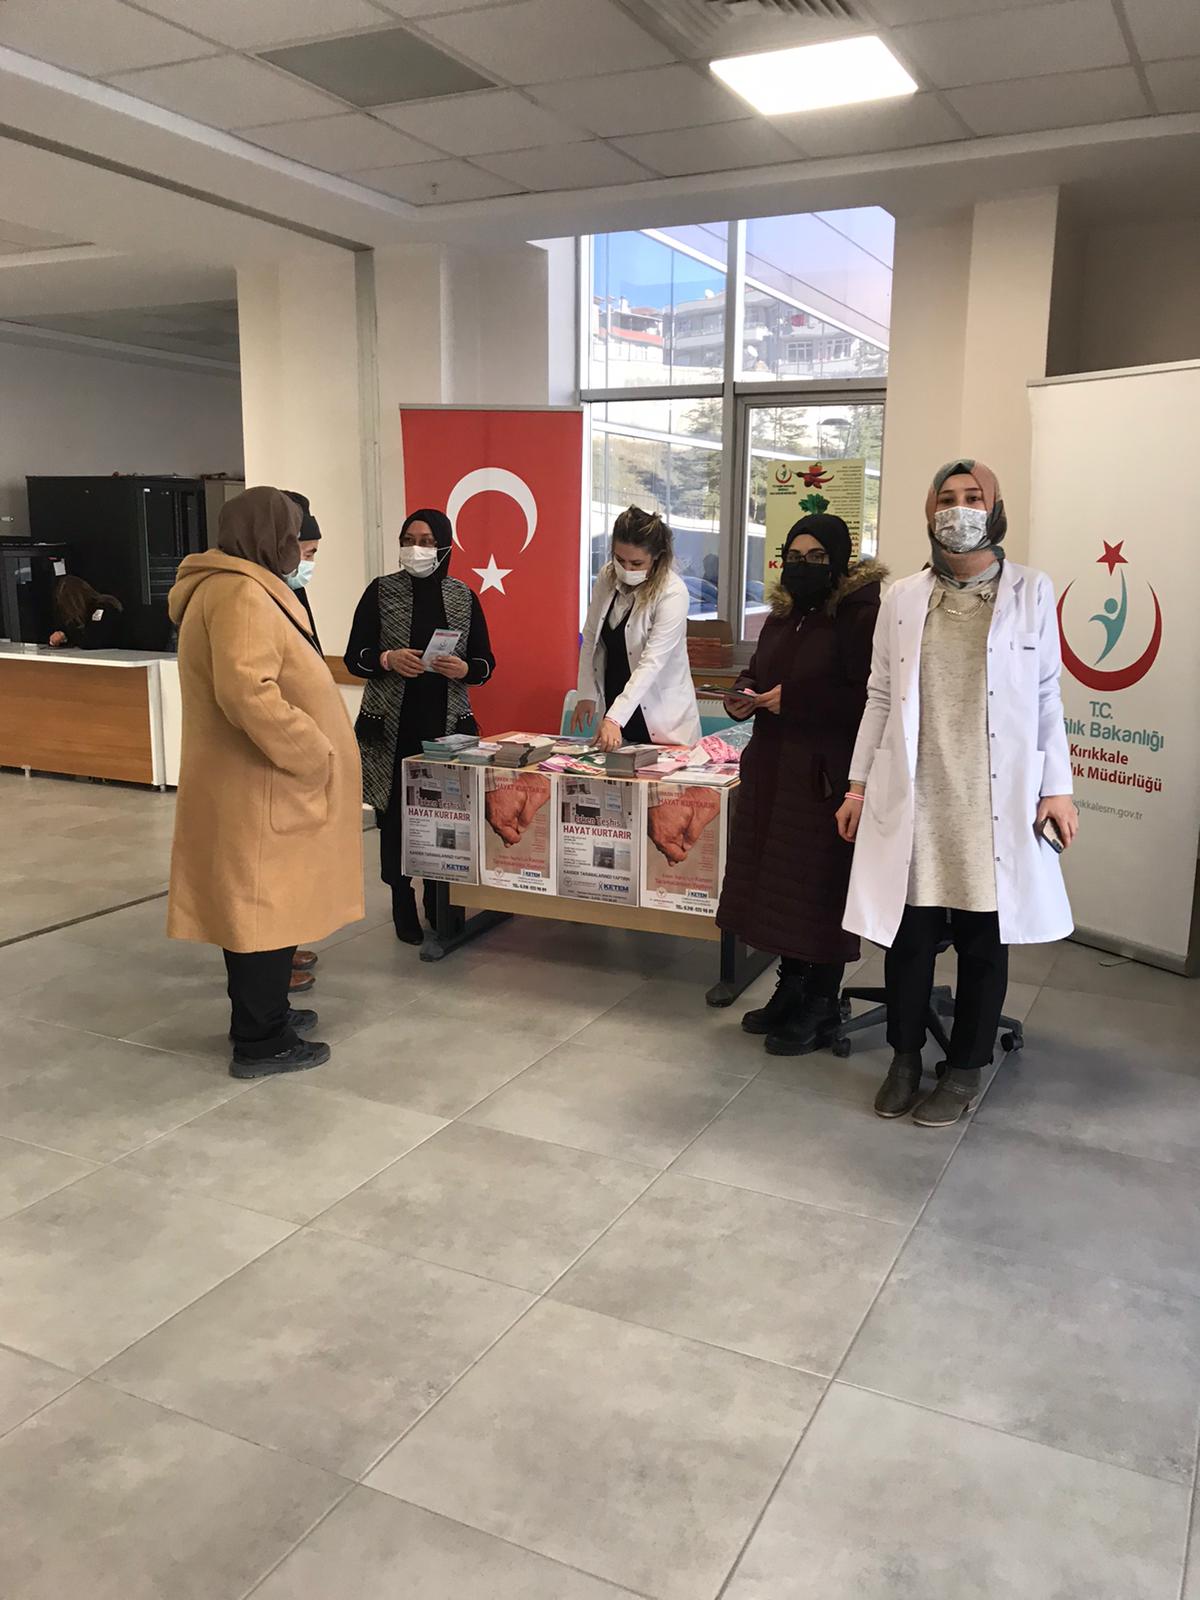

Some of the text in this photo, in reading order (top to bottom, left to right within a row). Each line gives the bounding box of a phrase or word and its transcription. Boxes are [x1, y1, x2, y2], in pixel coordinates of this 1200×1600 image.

[1089, 701, 1113, 719] T.C.
[1090, 722, 1164, 752] Bakanlığı
[1070, 744, 1129, 765] Kırıkkale
[1087, 766, 1162, 793] Müdürlüğü
[408, 808, 434, 818] HAYAT
[434, 809, 471, 822] KURTARIR
[563, 825, 632, 840] HAYAT KURTARIR
[603, 883, 629, 892] KETEM
